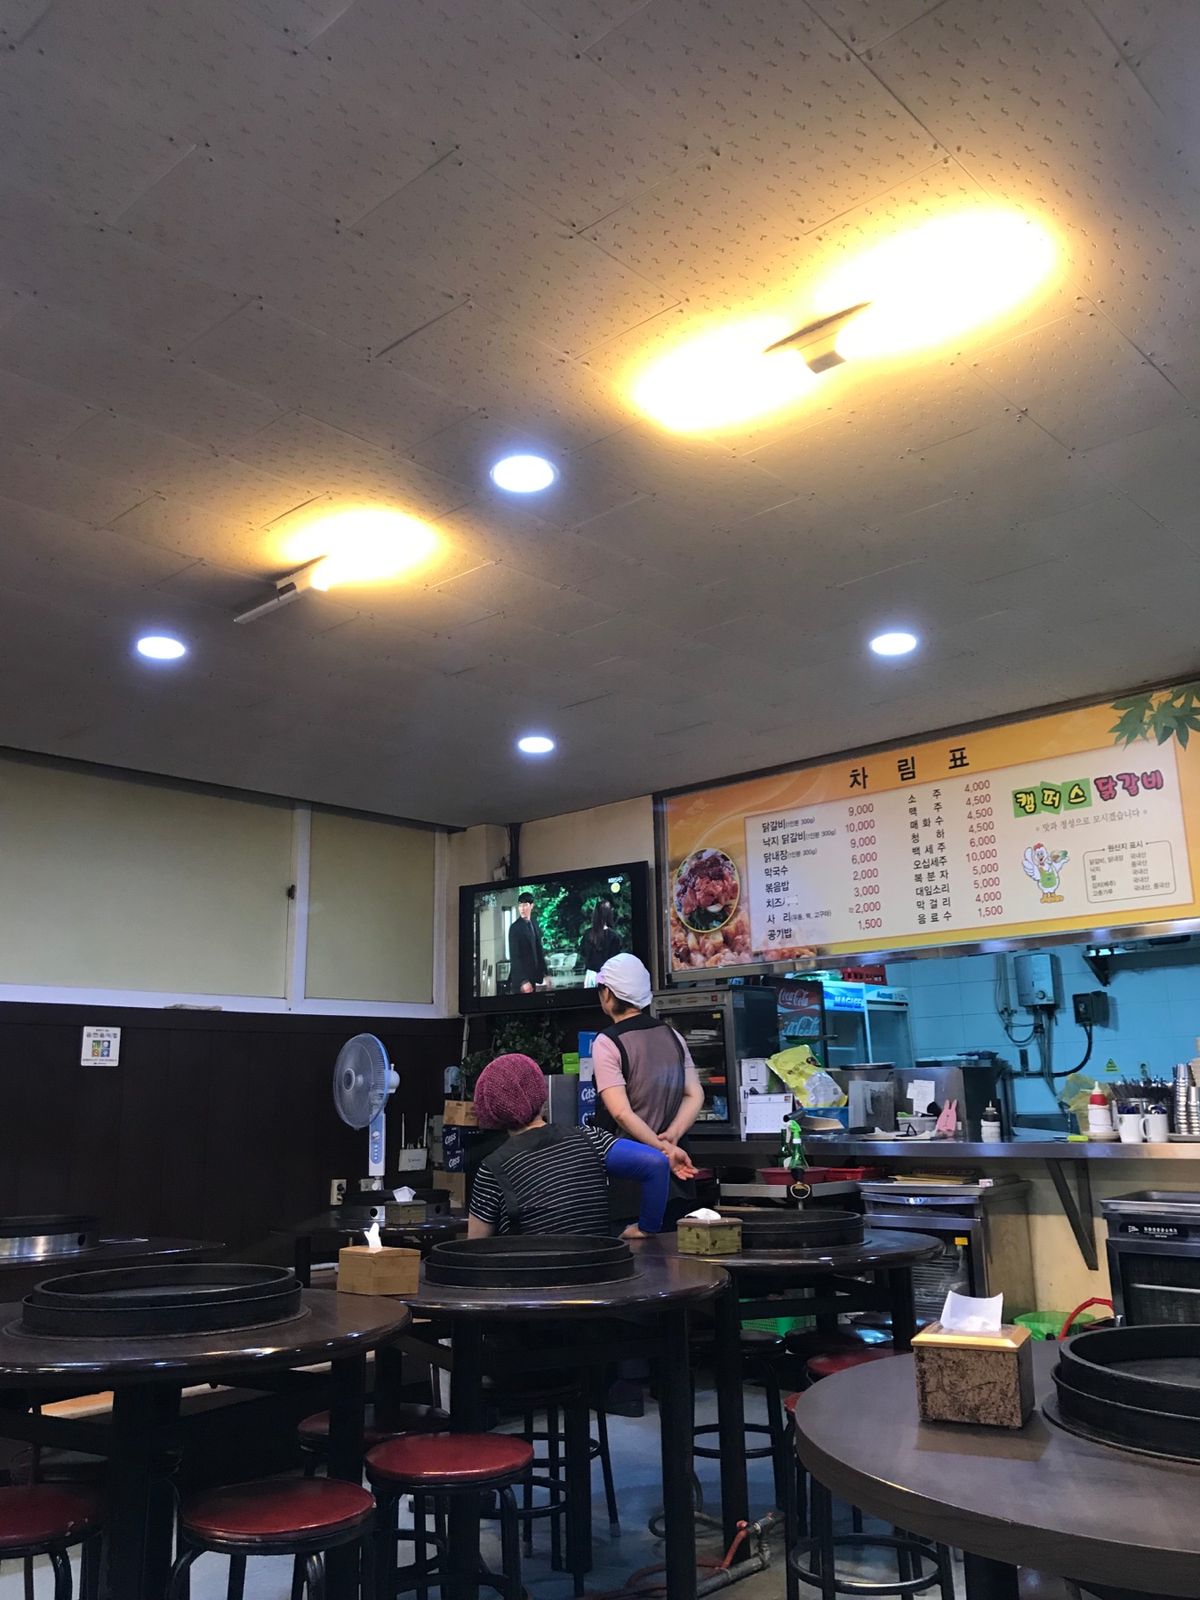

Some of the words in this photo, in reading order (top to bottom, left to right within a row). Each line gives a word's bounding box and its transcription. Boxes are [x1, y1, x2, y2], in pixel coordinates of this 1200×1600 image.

[964, 779, 991, 793] 4,000
[1015, 783, 1087, 814] 캠퍼스
[1094, 769, 1164, 801] 닭갈비
[965, 793, 992, 807] 4,500
[848, 803, 874, 816] 9,000
[967, 807, 993, 820] 4,500
[1093, 809, 1140, 823] 모시겠습니다
[763, 836, 779, 847] 낙지
[845, 819, 875, 833] 10,000
[968, 821, 995, 834] 4,500
[850, 835, 876, 848] 9,000
[969, 835, 996, 848] 6,000
[764, 865, 788, 878] 막국수
[851, 851, 878, 865] 6,000
[913, 856, 948, 870] 오십세주
[966, 849, 997, 863] 10,000
[972, 863, 999, 876] 5,000
[765, 881, 789, 894] 볶음밥
[853, 868, 879, 881] 2,000
[973, 876, 1000, 890] 5,000
[854, 884, 880, 897] 3,000
[975, 891, 1002, 904] 4,000
[978, 905, 1003, 918] 1,500
[767, 928, 792, 941] 공기밥
[858, 918, 882, 931] 1,500
[581, 1088, 596, 1101] Cas
